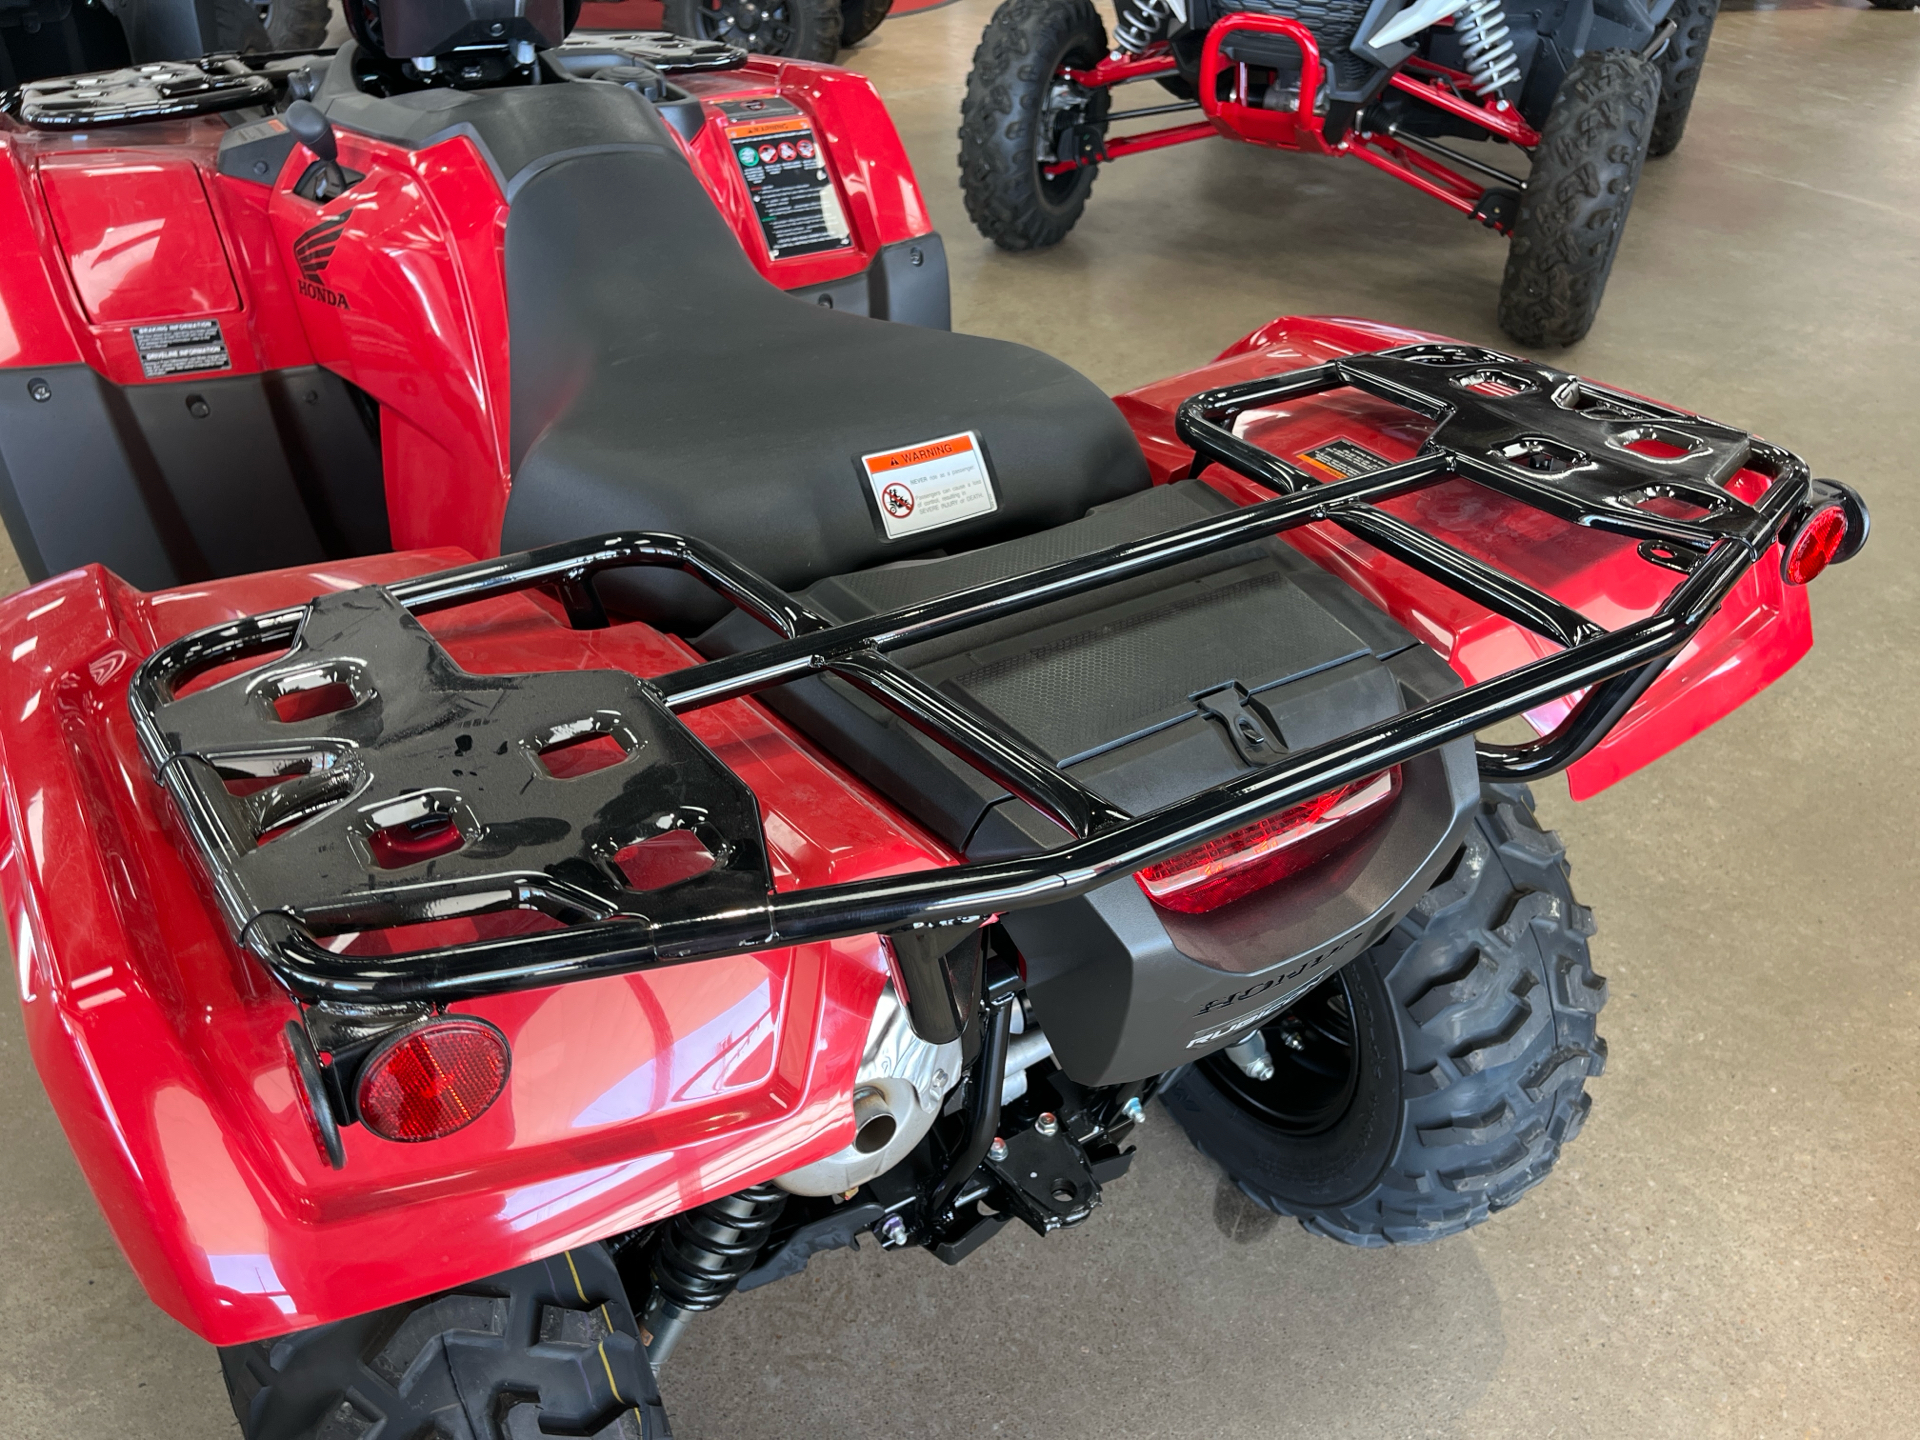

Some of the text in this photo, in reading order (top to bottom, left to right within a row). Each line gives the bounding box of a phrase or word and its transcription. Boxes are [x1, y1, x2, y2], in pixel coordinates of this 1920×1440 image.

[297, 278, 350, 310] HONDA
[902, 443, 953, 464] WARNING
[910, 477, 928, 485] NEVER
[952, 484, 966, 492] cause
[919, 505, 940, 514] SEVERE
[941, 500, 958, 509] INJURY
